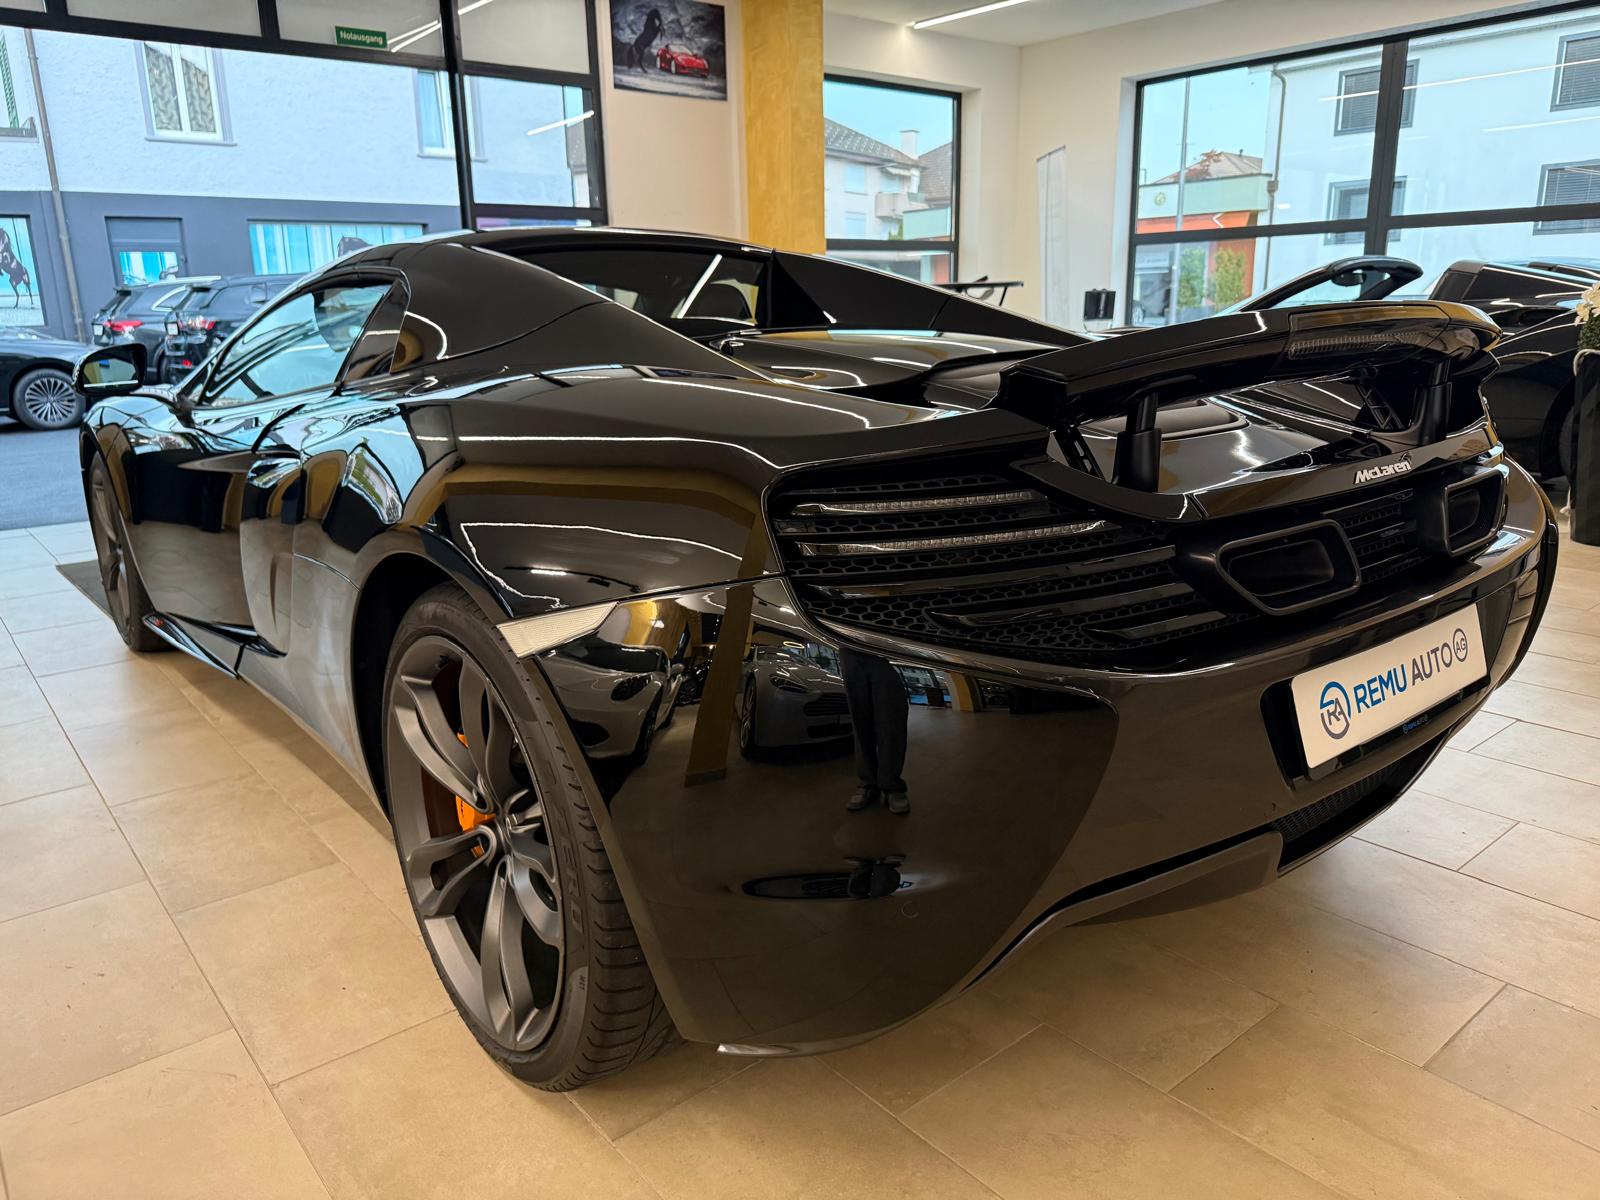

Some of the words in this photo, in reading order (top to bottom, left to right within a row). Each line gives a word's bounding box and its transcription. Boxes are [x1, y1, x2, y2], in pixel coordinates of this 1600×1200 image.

[340, 30, 383, 45] Notausgang
[1355, 460, 1411, 484] McLaren
[1353, 664, 1408, 714] REMU
[1412, 642, 1453, 686] AUTO
